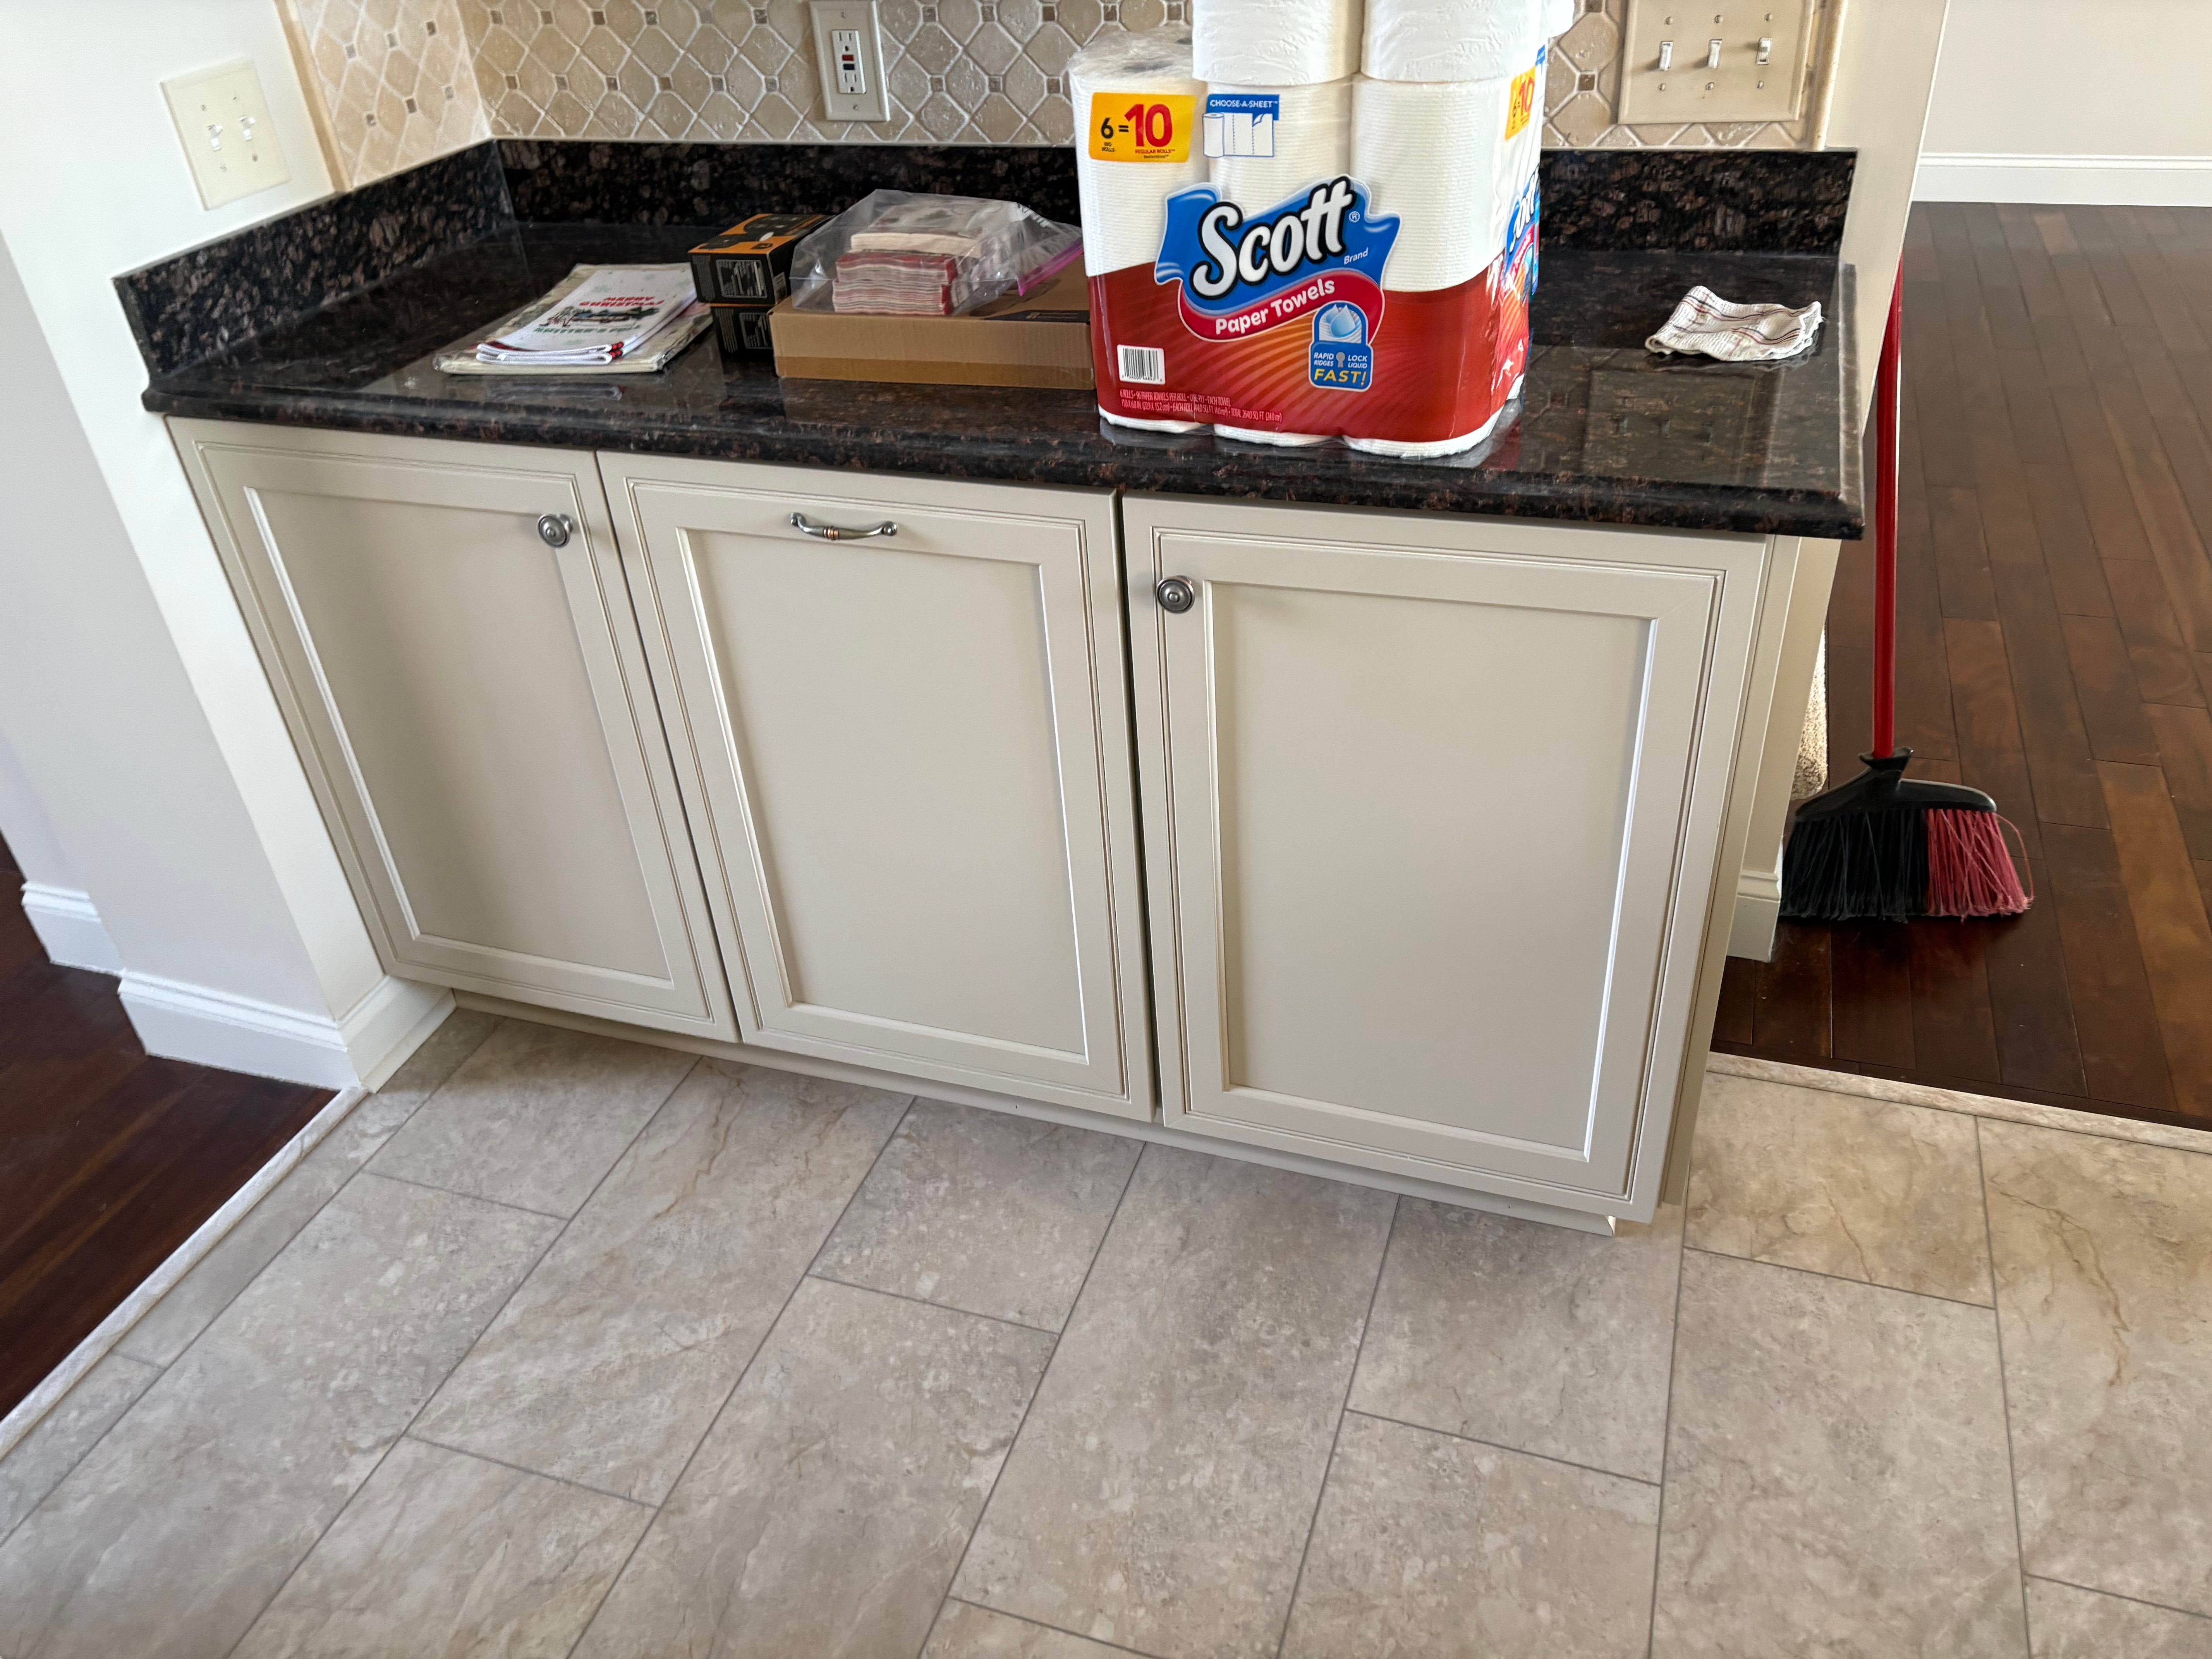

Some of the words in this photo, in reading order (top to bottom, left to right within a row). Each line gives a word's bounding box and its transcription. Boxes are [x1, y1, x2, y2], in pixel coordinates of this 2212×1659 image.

[1101, 117, 1114, 139] 6
[1124, 103, 1173, 148] 10
[1191, 178, 1355, 298] Scott
[1343, 247, 1369, 265] Brand
[1215, 308, 1269, 335] Paper
[1270, 278, 1335, 317] Towels
[1313, 352, 1334, 360] RAPID
[1314, 369, 1367, 386] FAST!
[1123, 389, 1134, 399] ROLLS
[1141, 391, 1153, 401] PAPER
[1154, 392, 1169, 402] TOWELS
[1177, 393, 1188, 402] ROLL
[1207, 395, 1218, 405] EACH
[1218, 397, 1231, 407] TOWEL
[1172, 402, 1184, 412] EACH
[1183, 403, 1194, 412] ROLL
[1231, 408, 1242, 418] TOTAL
